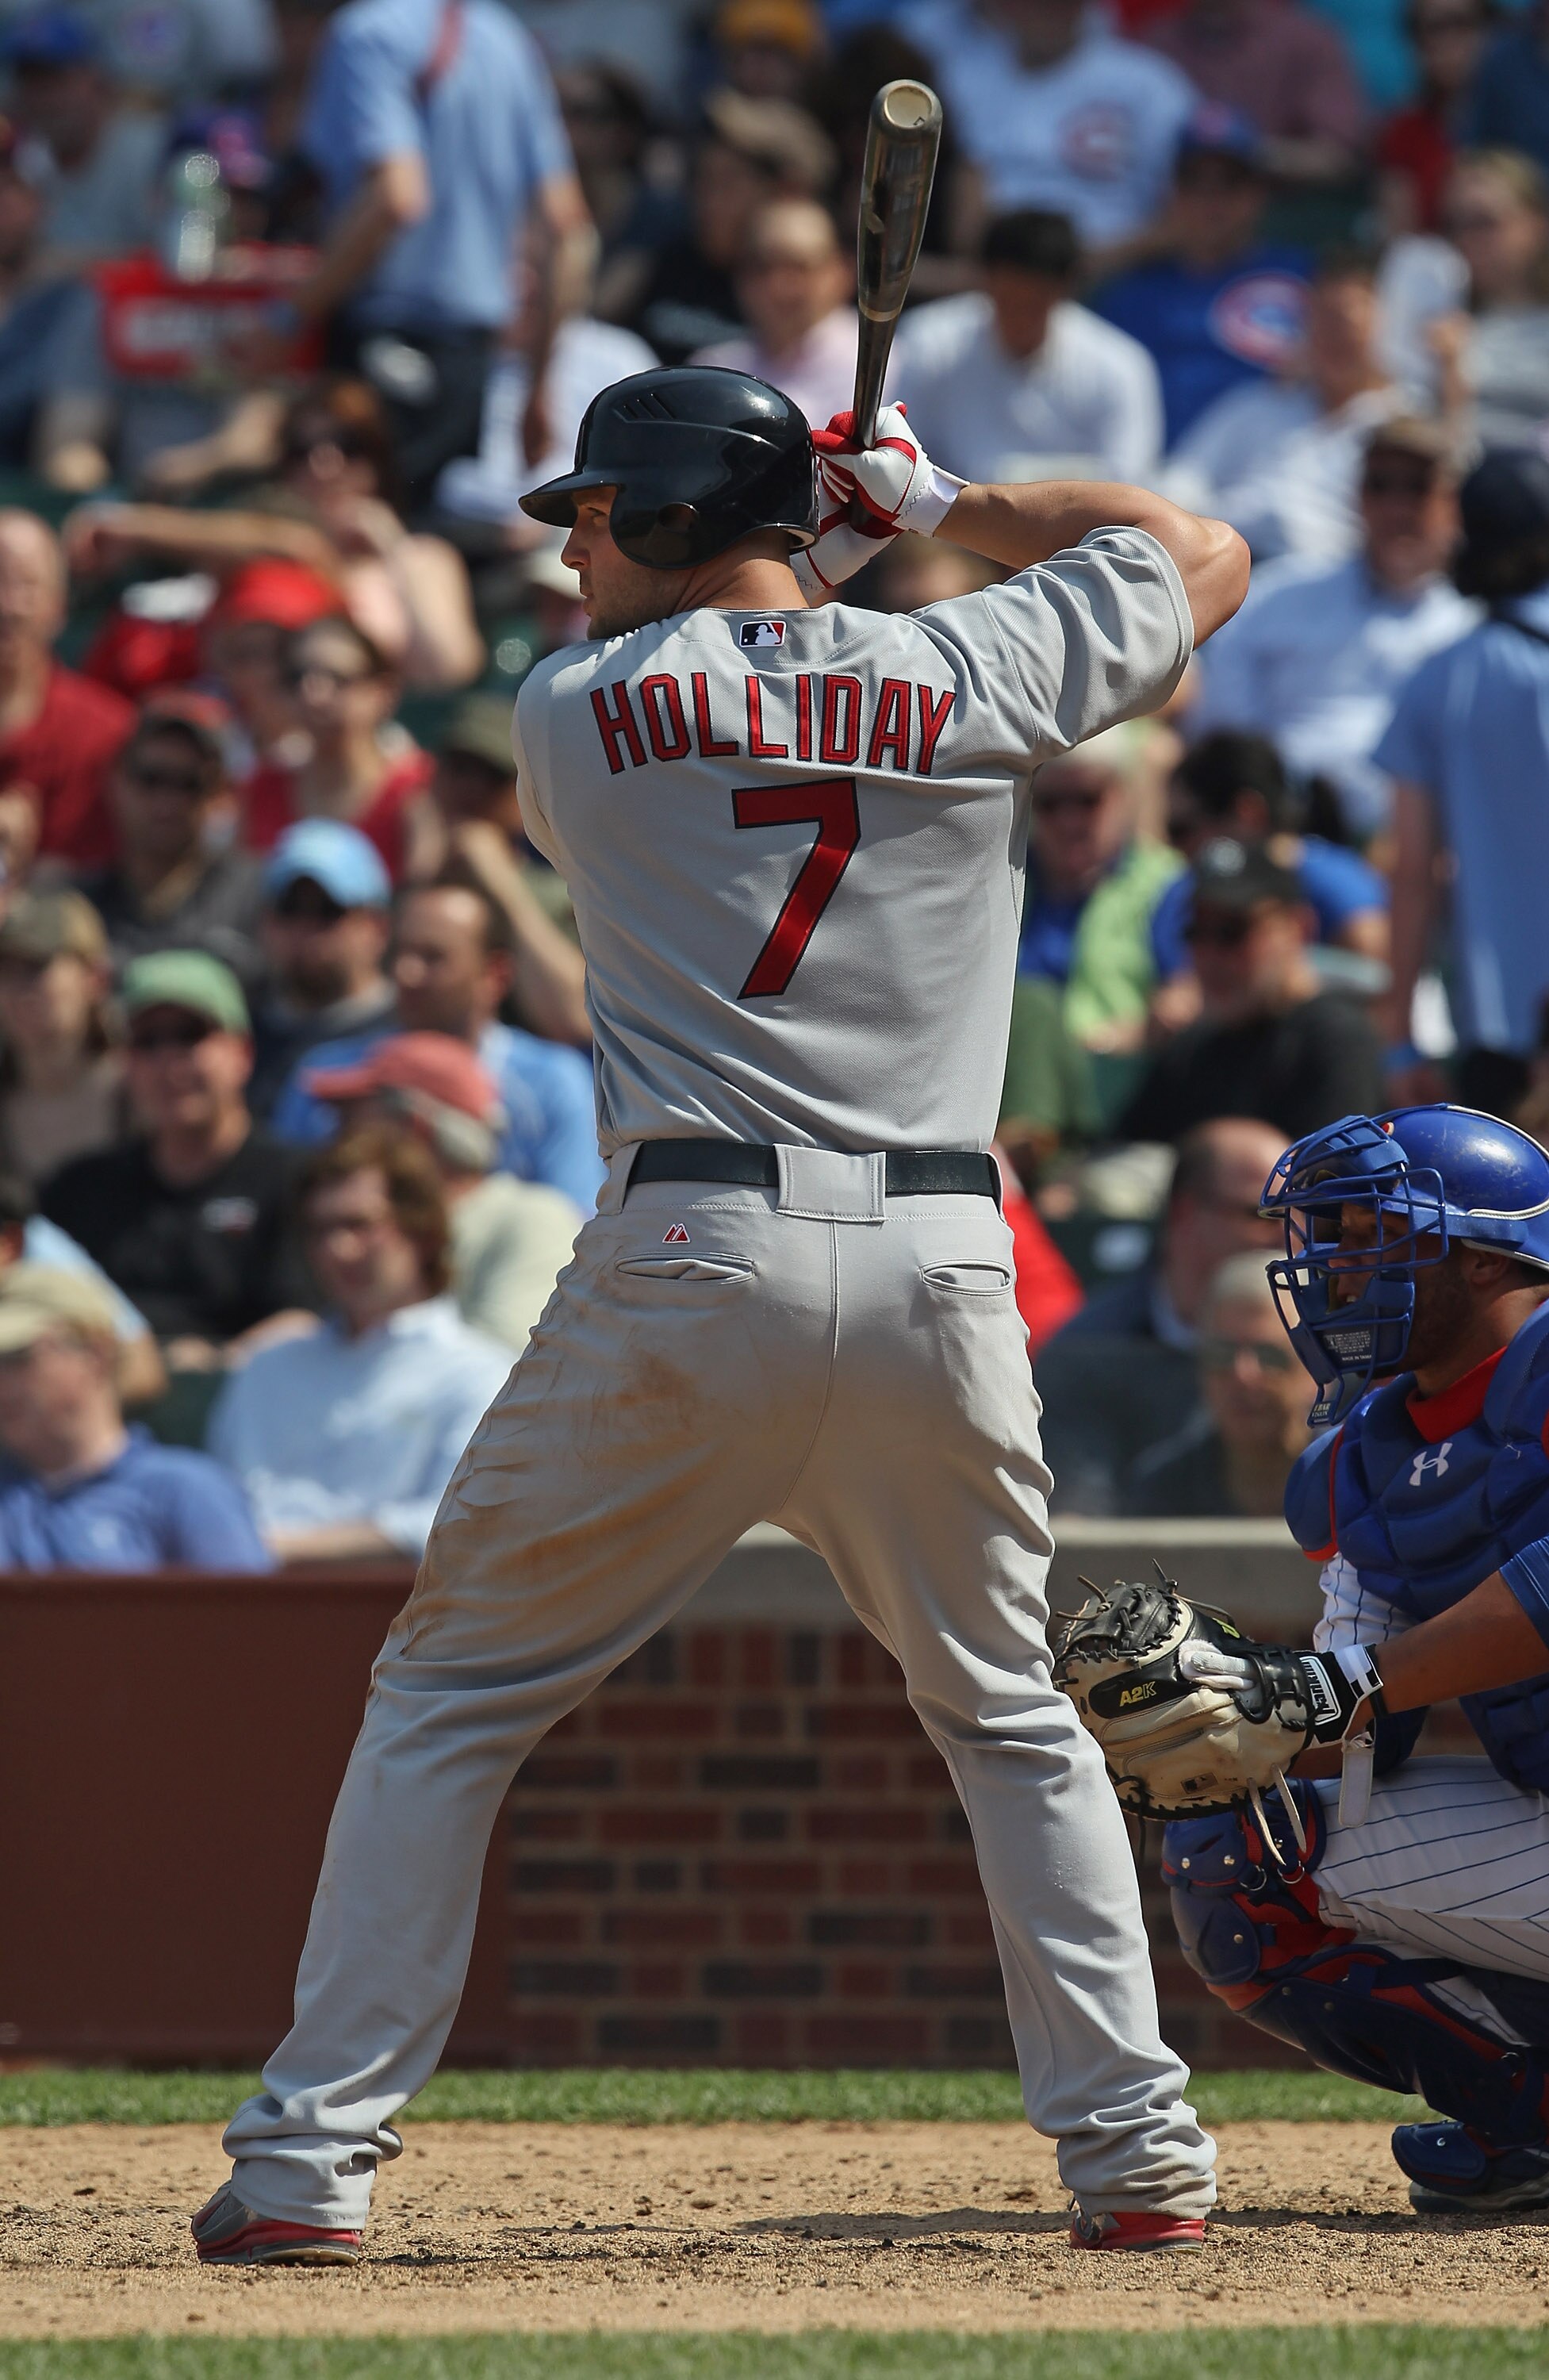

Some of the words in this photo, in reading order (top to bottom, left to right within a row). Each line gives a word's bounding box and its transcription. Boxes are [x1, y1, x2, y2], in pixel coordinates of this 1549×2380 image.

[590, 672, 957, 776] HOLLIDAY
[731, 777, 861, 1000] 7
[1119, 1681, 1156, 1707] A2K
